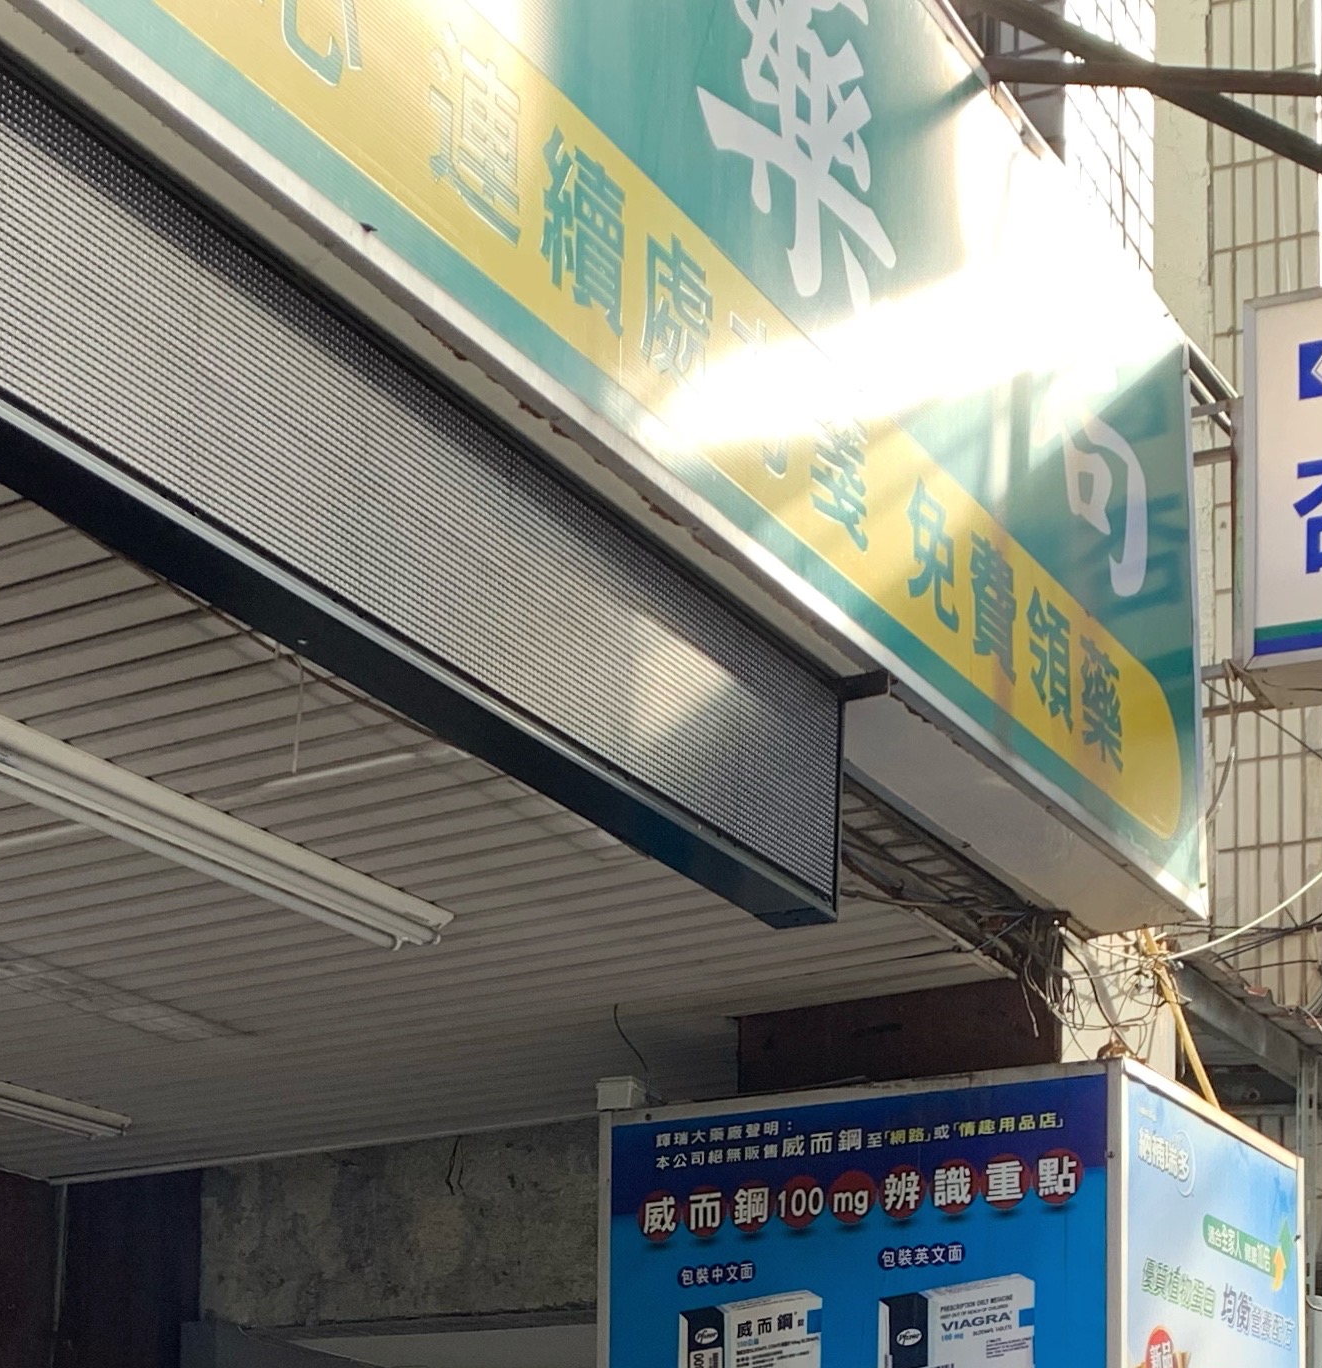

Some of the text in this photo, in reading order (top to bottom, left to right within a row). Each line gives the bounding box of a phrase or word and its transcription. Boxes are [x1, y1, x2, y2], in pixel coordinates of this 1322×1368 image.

[906, 474, 1124, 774] 免費領藥
[643, 1155, 1078, 1235] 威而鋼 100 mg 辨識重點
[881, 1244, 964, 1268] 包裝英文面
[681, 1262, 754, 1286] 包裝中文面
[941, 1311, 1011, 1332] VIAGRA
